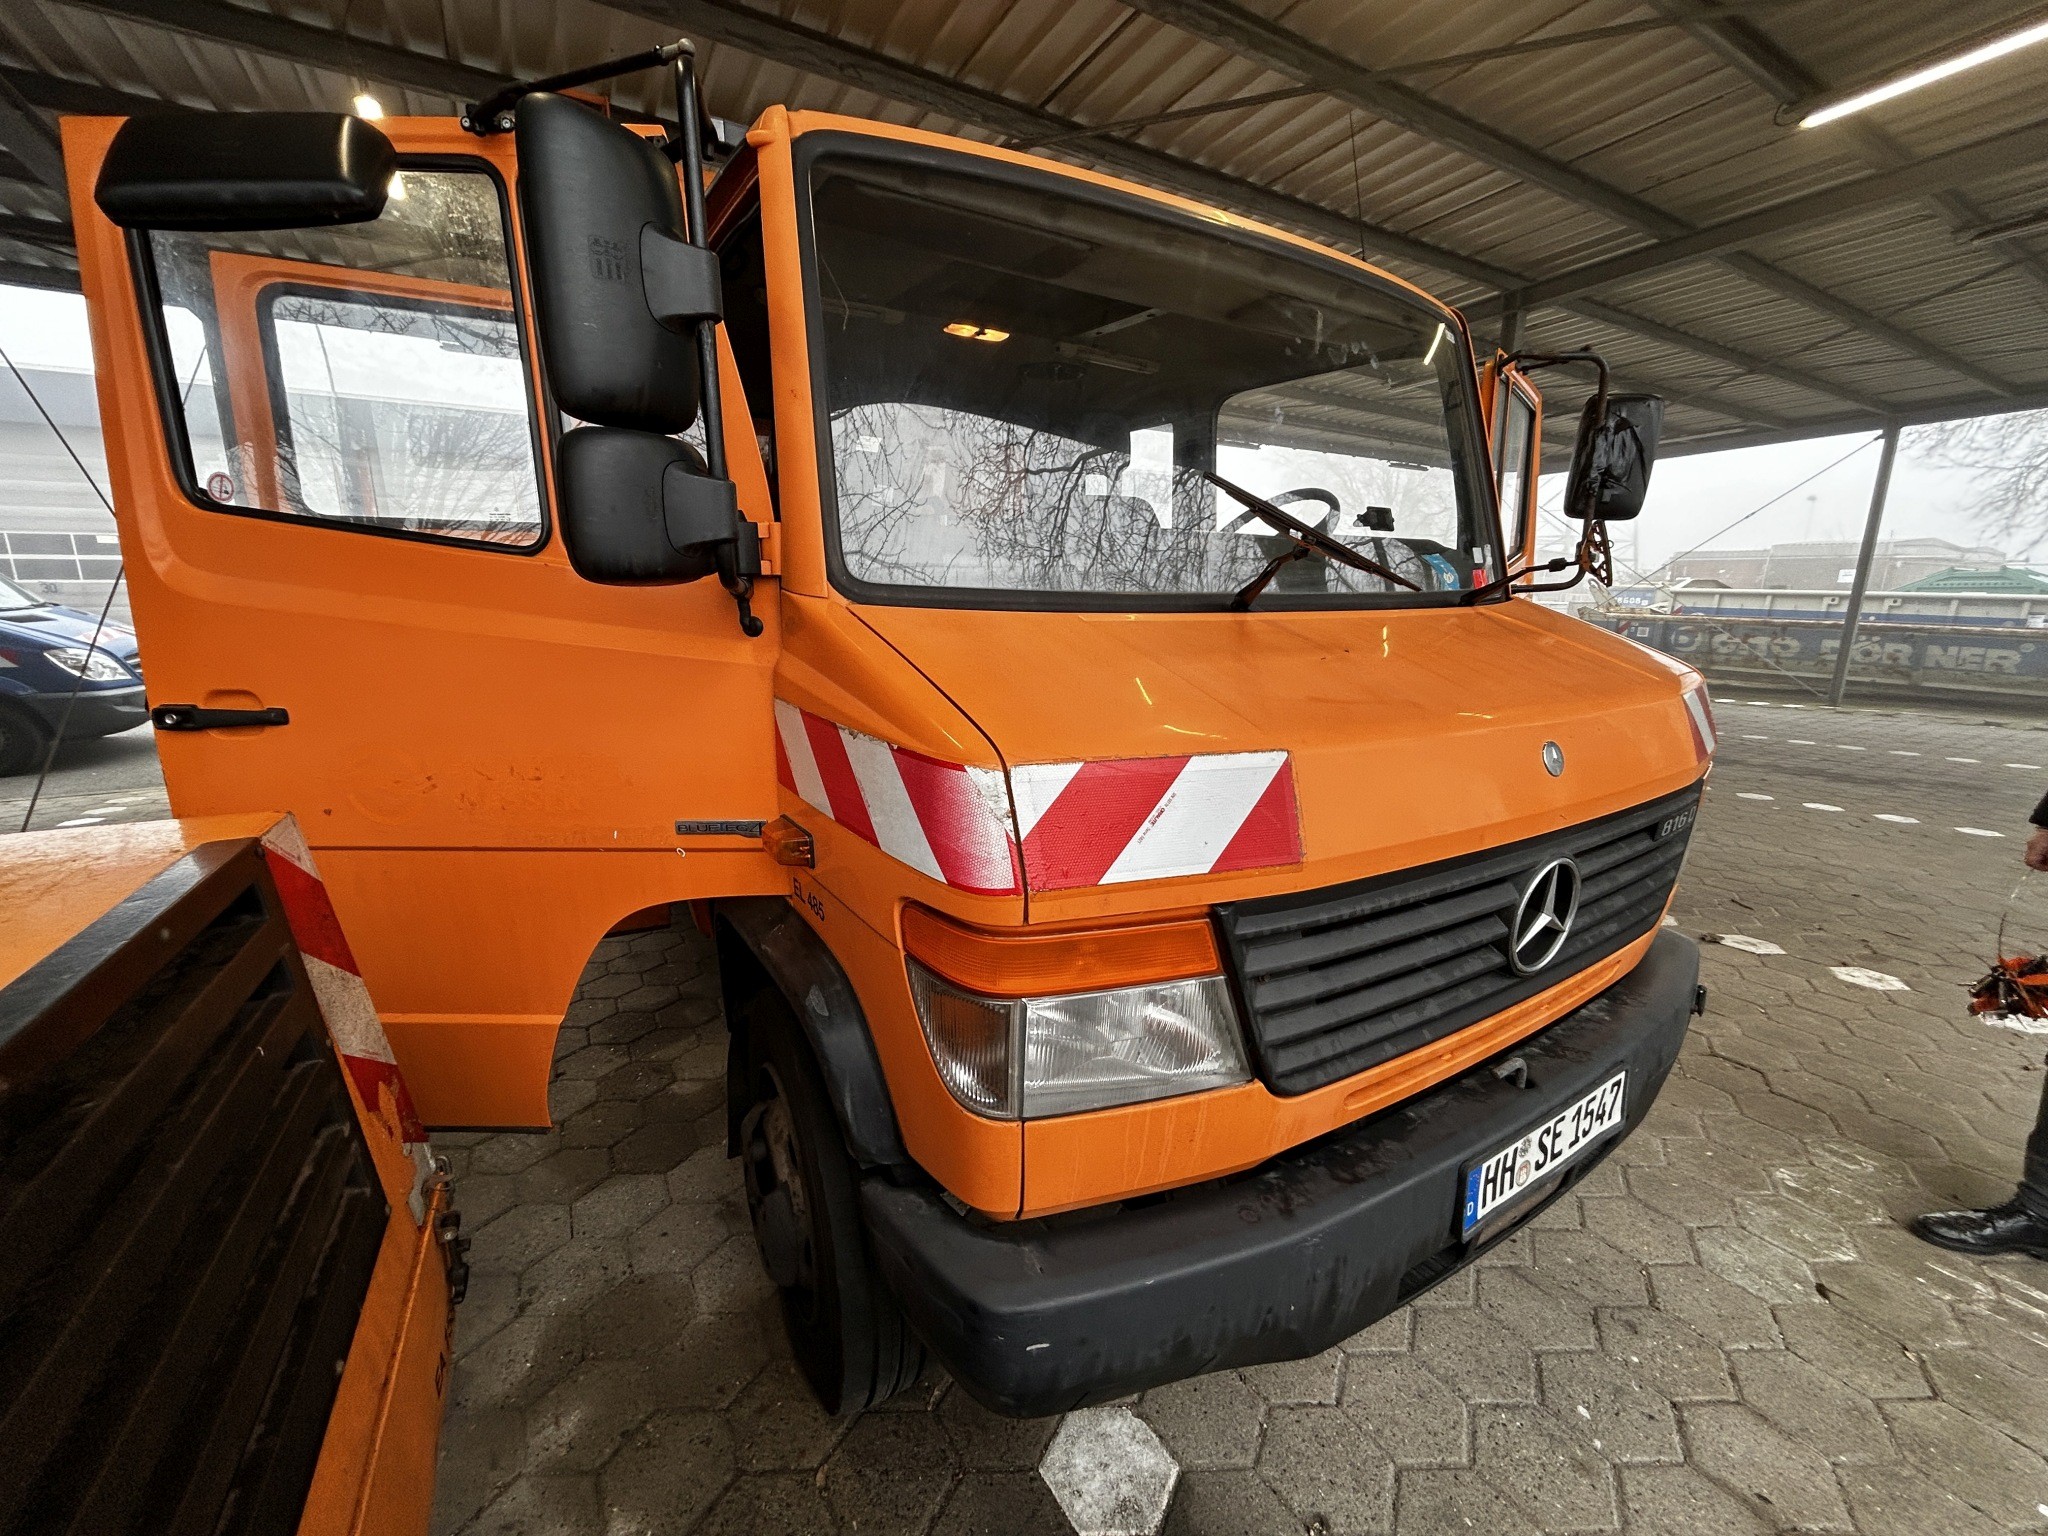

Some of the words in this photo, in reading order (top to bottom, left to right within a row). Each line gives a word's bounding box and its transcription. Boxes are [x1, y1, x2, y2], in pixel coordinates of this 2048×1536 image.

[793, 876, 806, 905] EL
[807, 891, 825, 922] 485
[1481, 1146, 1519, 1210] HH
[1534, 1114, 1566, 1172] SE
[1568, 1077, 1622, 1149] 1547
[1467, 1201, 1474, 1217] D
